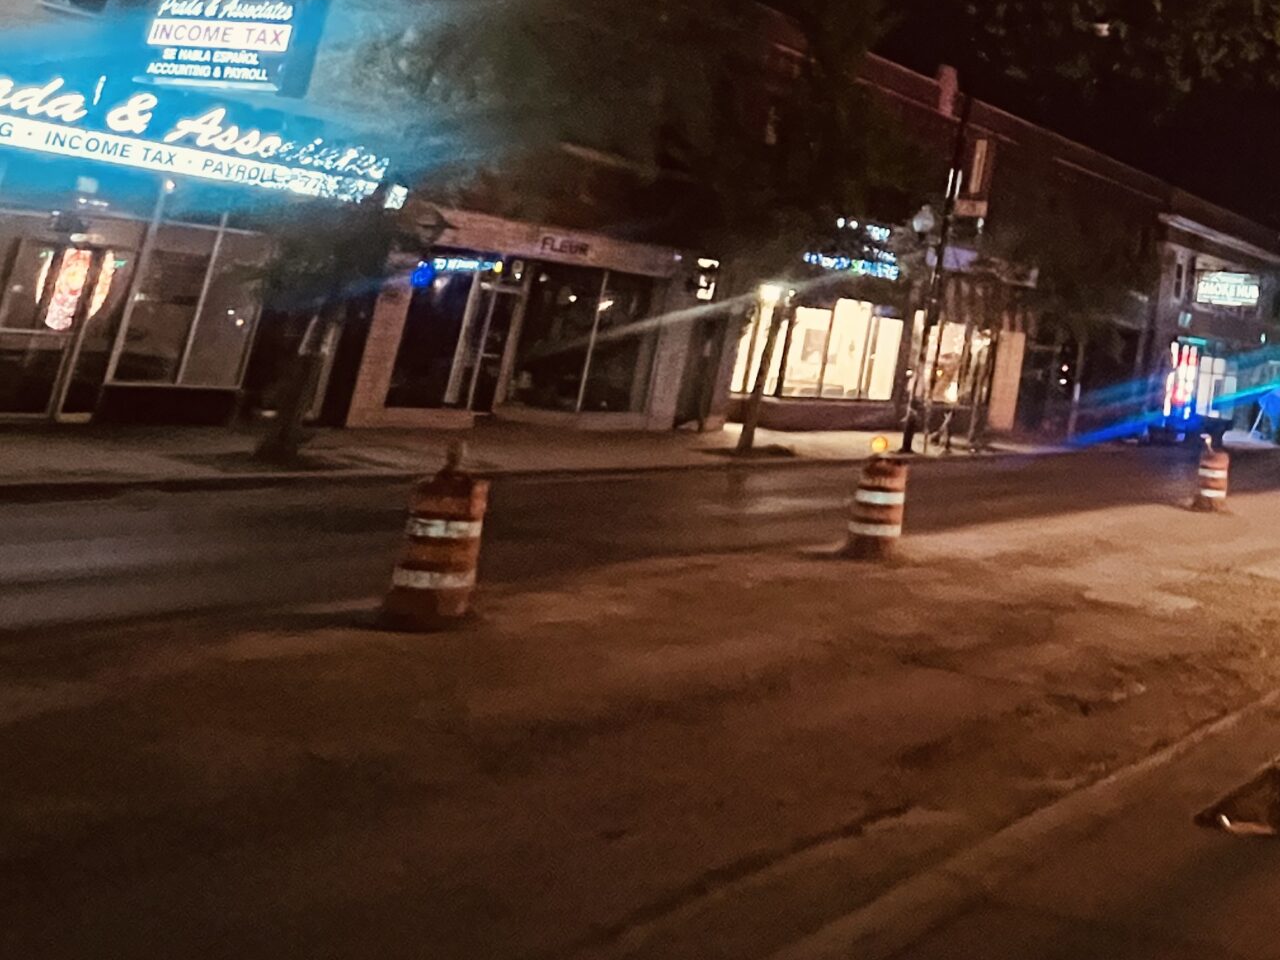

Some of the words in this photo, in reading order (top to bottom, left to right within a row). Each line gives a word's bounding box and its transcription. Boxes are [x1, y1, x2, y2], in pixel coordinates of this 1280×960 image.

[153, 24, 234, 43] INCOME
[246, 28, 285, 46] TAX
[146, 63, 211, 77] ACCOUNTING
[223, 67, 268, 80] PAYROLL
[106, 93, 158, 134] &
[45, 131, 133, 158] INCOME
[143, 147, 177, 166] TAX
[203, 159, 276, 182] PAYROLL
[540, 236, 590, 256] FLEUR
